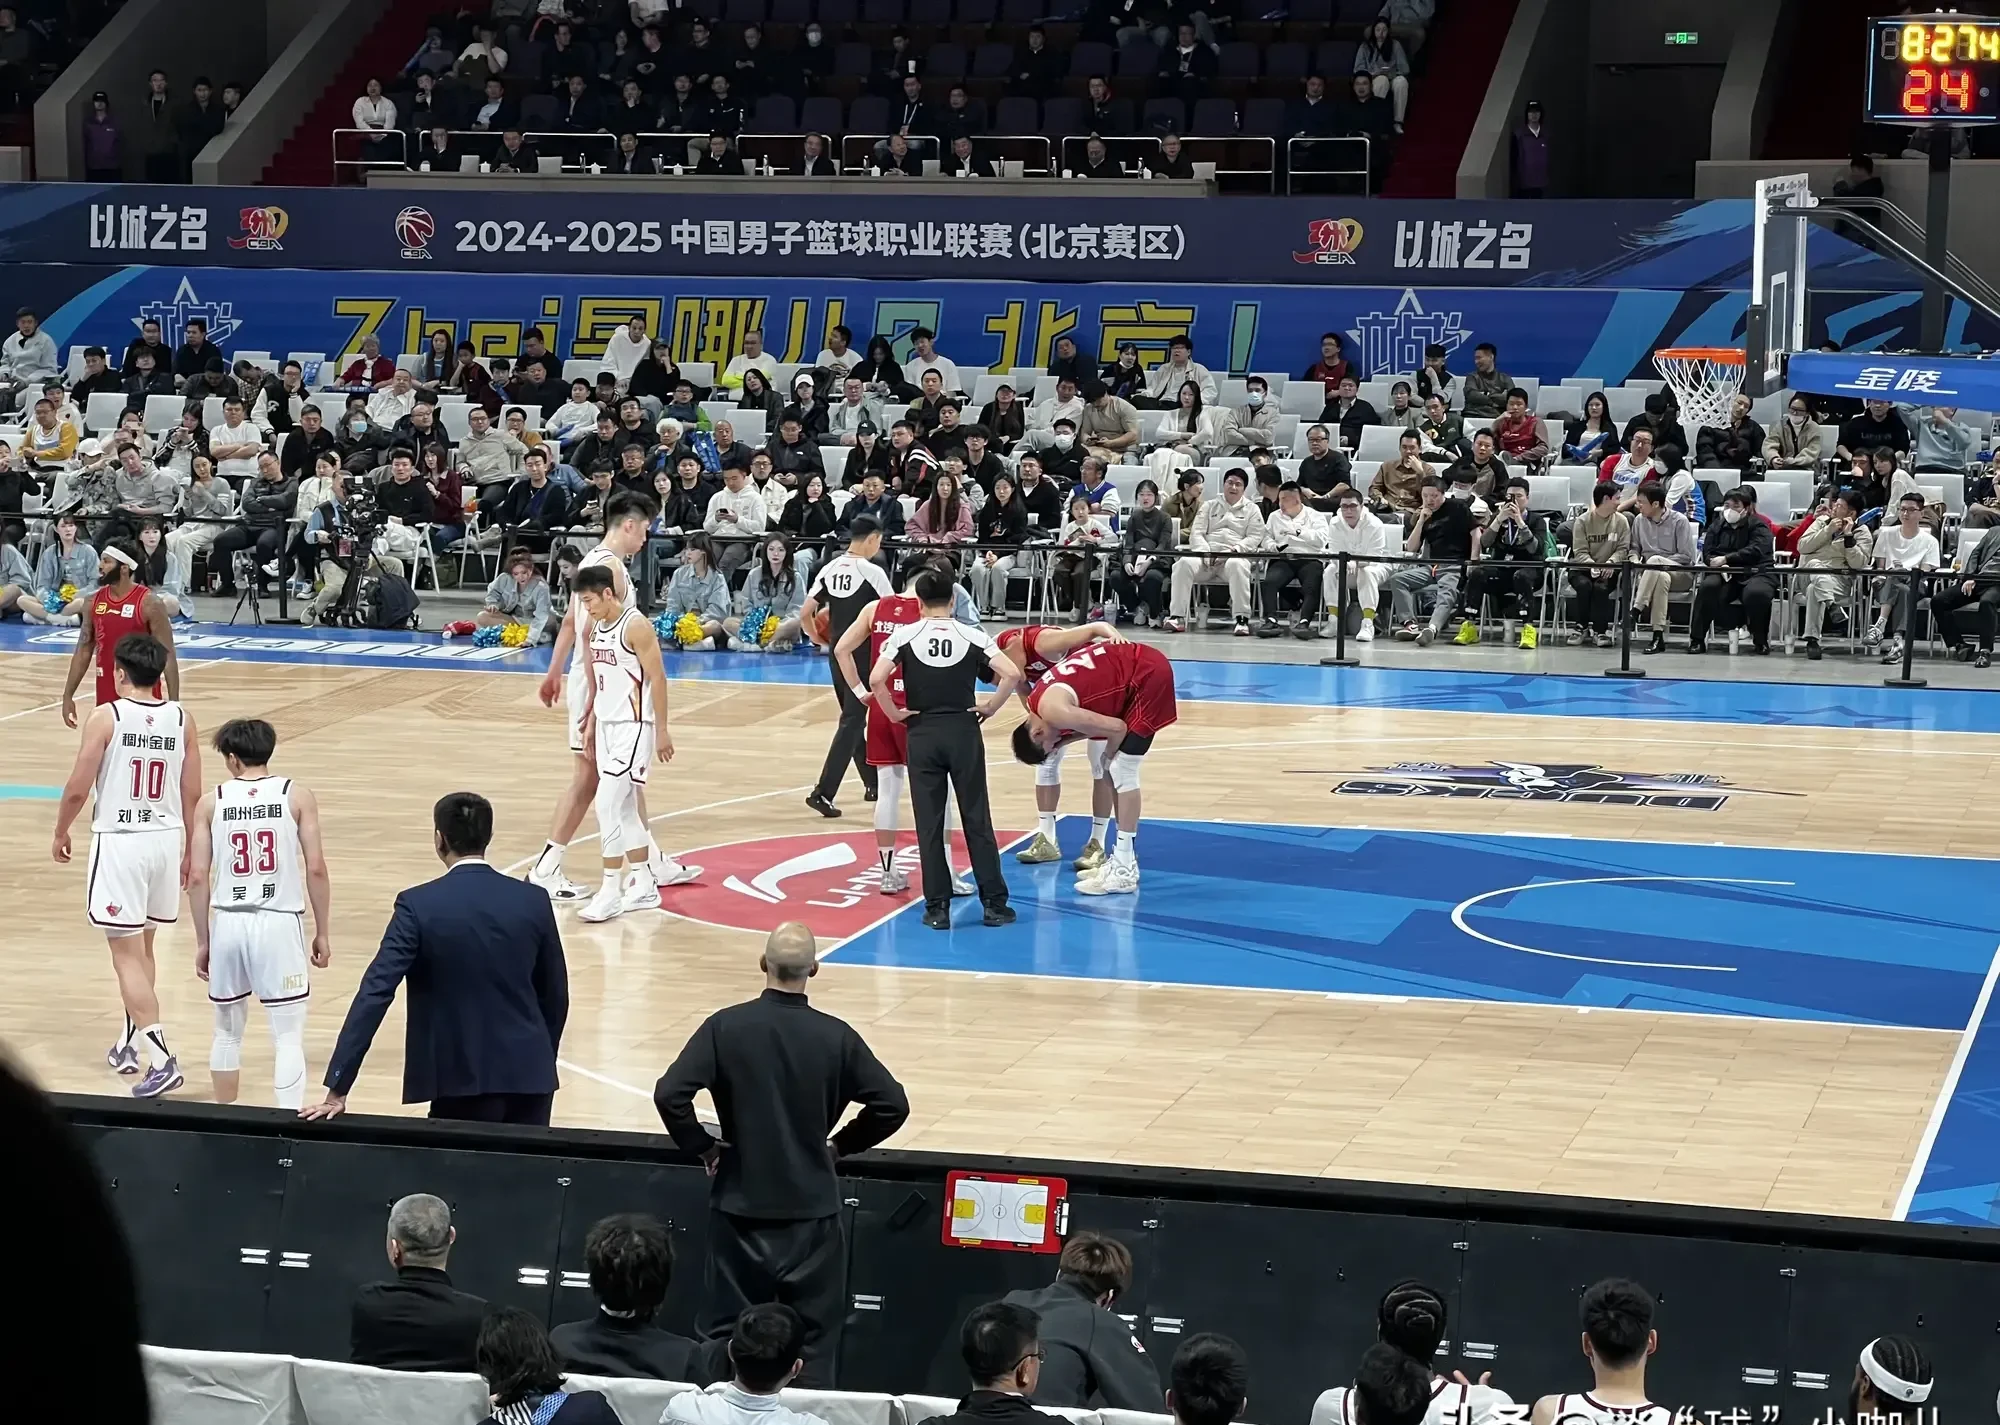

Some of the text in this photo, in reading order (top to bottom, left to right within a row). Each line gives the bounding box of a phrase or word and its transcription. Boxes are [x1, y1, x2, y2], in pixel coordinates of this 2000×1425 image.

[1903, 69, 1968, 112] 24
[90, 204, 208, 251] 以城之名
[247, 238, 283, 250] CBA
[454, 220, 662, 253] 2024-2025
[1394, 219, 1533, 269] 以城之名
[400, 248, 433, 260] CBA
[1314, 252, 1356, 265] CBA
[1835, 367, 1958, 395] 金陵
[831, 573, 853, 591] 113
[928, 637, 952, 658] 30
[129, 757, 167, 802] 10
[1330, 779, 1729, 812] DUCKS
[228, 828, 278, 877] 33
